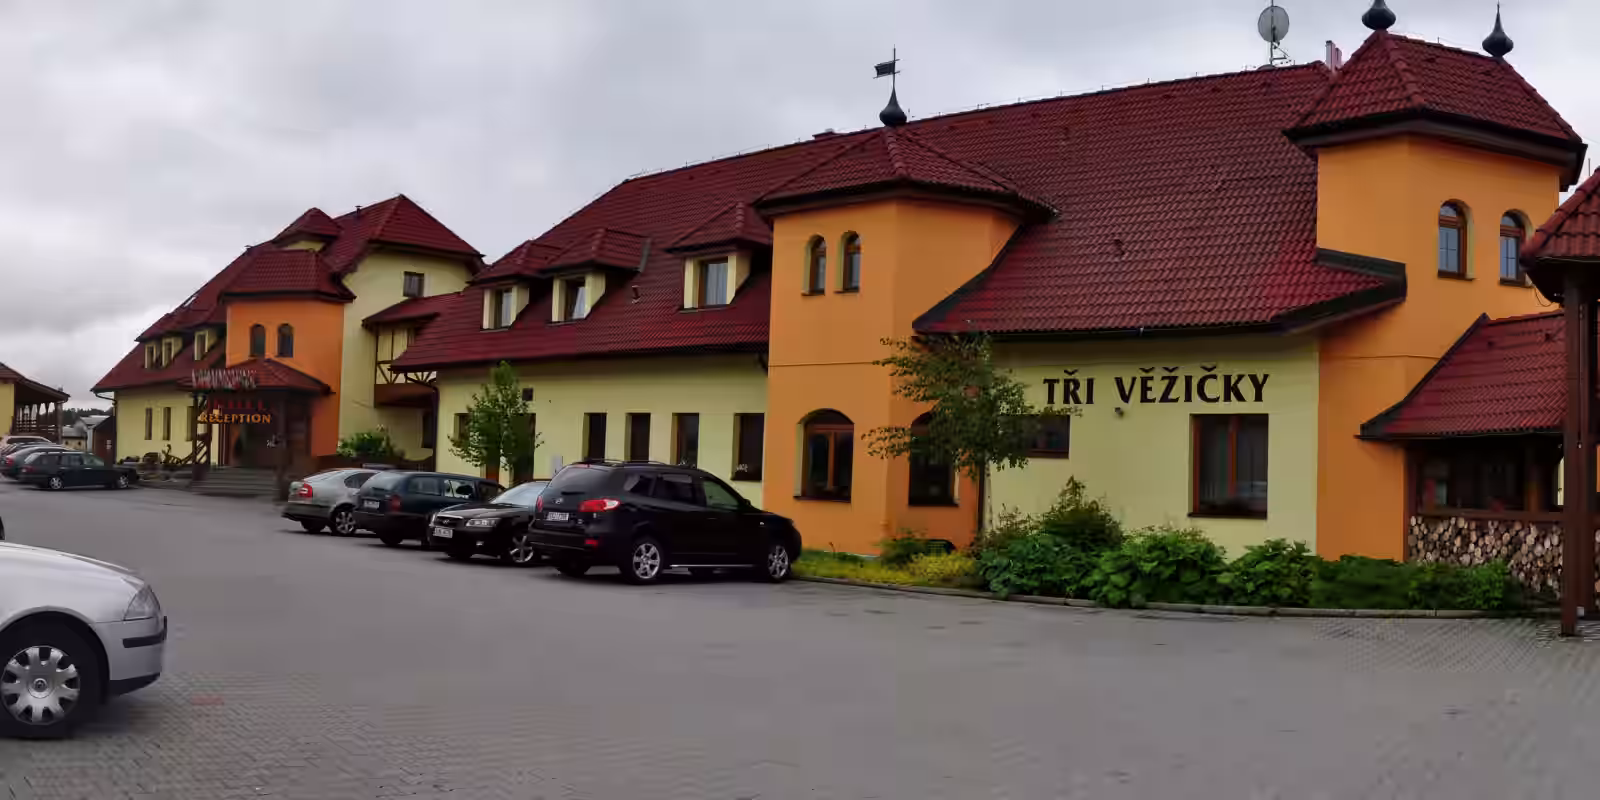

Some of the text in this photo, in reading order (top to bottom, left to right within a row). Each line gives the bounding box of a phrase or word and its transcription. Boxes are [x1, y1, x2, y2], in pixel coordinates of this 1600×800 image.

[1043, 365, 1270, 405] TŘI VĚŽIČKY
[199, 413, 272, 424] RECEPTION
